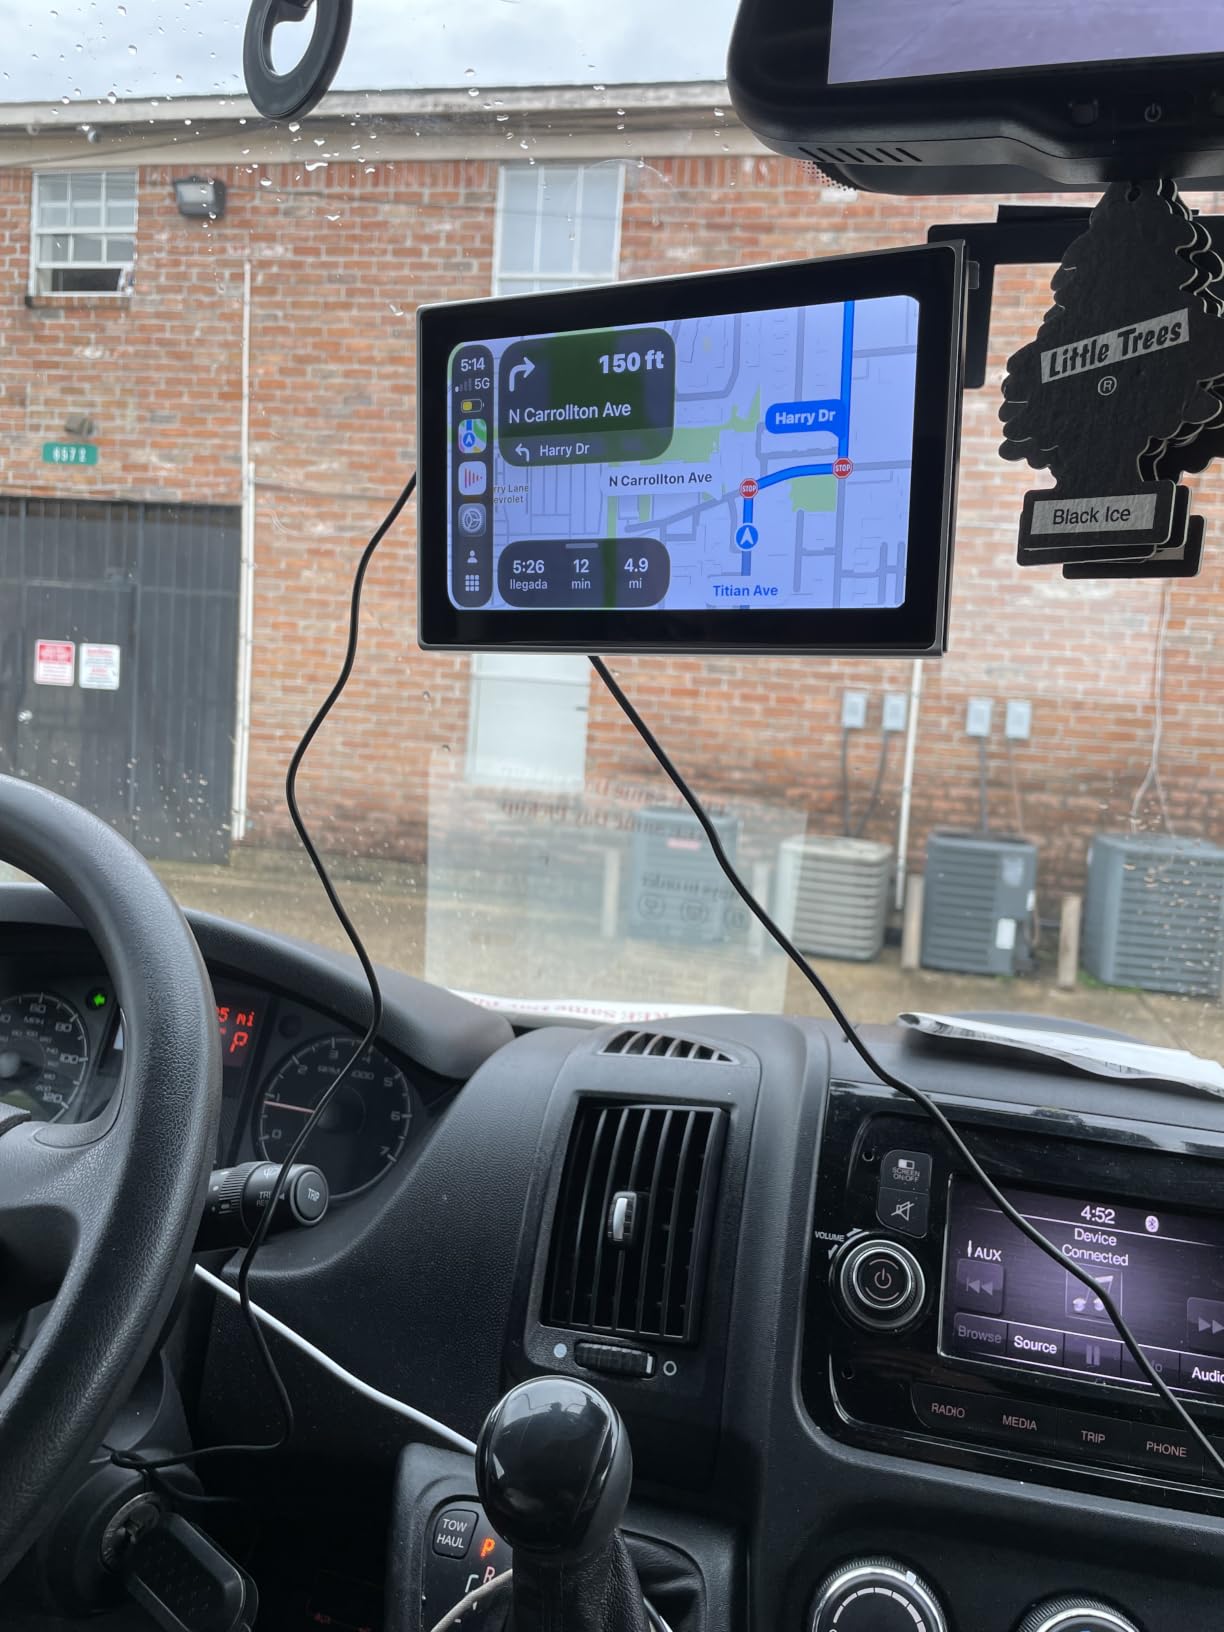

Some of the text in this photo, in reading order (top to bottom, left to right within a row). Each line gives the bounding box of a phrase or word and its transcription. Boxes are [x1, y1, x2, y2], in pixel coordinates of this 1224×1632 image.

[1048, 321, 1183, 379] Little Trees
[460, 357, 486, 372] 5:14
[599, 349, 665, 374] 150 ft
[474, 377, 490, 390] 5G
[509, 402, 631, 424] N Carrollton Ave
[775, 408, 837, 426] Harry Dr
[539, 442, 590, 458] Harry Dr
[835, 463, 851, 473] STOP
[609, 471, 713, 487] N Carrollton Ave
[494, 484, 529, 493] rry Lane
[741, 484, 757, 493] STOP
[494, 495, 524, 504] evrolet
[1052, 505, 1132, 526] Black Ice
[512, 560, 545, 574] 5:26
[573, 559, 590, 573] 12
[624, 558, 649, 573] 4.9
[509, 578, 548, 592] llegada
[571, 578, 591, 589] min
[629, 577, 643, 589] mi
[713, 584, 779, 597] Titian Ave
[55, 1022, 73, 1033] 80
[230, 1032, 248, 1054] P
[59, 1053, 79, 1065] 100
[328, 1050, 339, 1060] 3
[297, 1064, 309, 1076] 2
[383, 1077, 394, 1088] 5
[390, 1110, 401, 1122] 6
[258, 1191, 272, 1199] TRI
[307, 1187, 321, 1203] TRIP
[1080, 1205, 1116, 1225] 4:52
[814, 1230, 846, 1243] VOLUME
[1073, 1227, 1118, 1247] Device
[974, 1245, 1003, 1262] AUX
[1061, 1243, 1130, 1267] Connected
[957, 1325, 1003, 1344] Browse
[1013, 1335, 1059, 1355] Source
[931, 1402, 967, 1419] RADIO
[1002, 1414, 1038, 1432] MEDIA
[1080, 1430, 1106, 1445] TRIP
[1145, 1441, 1188, 1458] PHONE
[442, 1518, 468, 1533] TOW
[436, 1533, 465, 1549] HAUL
[480, 1537, 496, 1559] P
[482, 1565, 496, 1584] R
